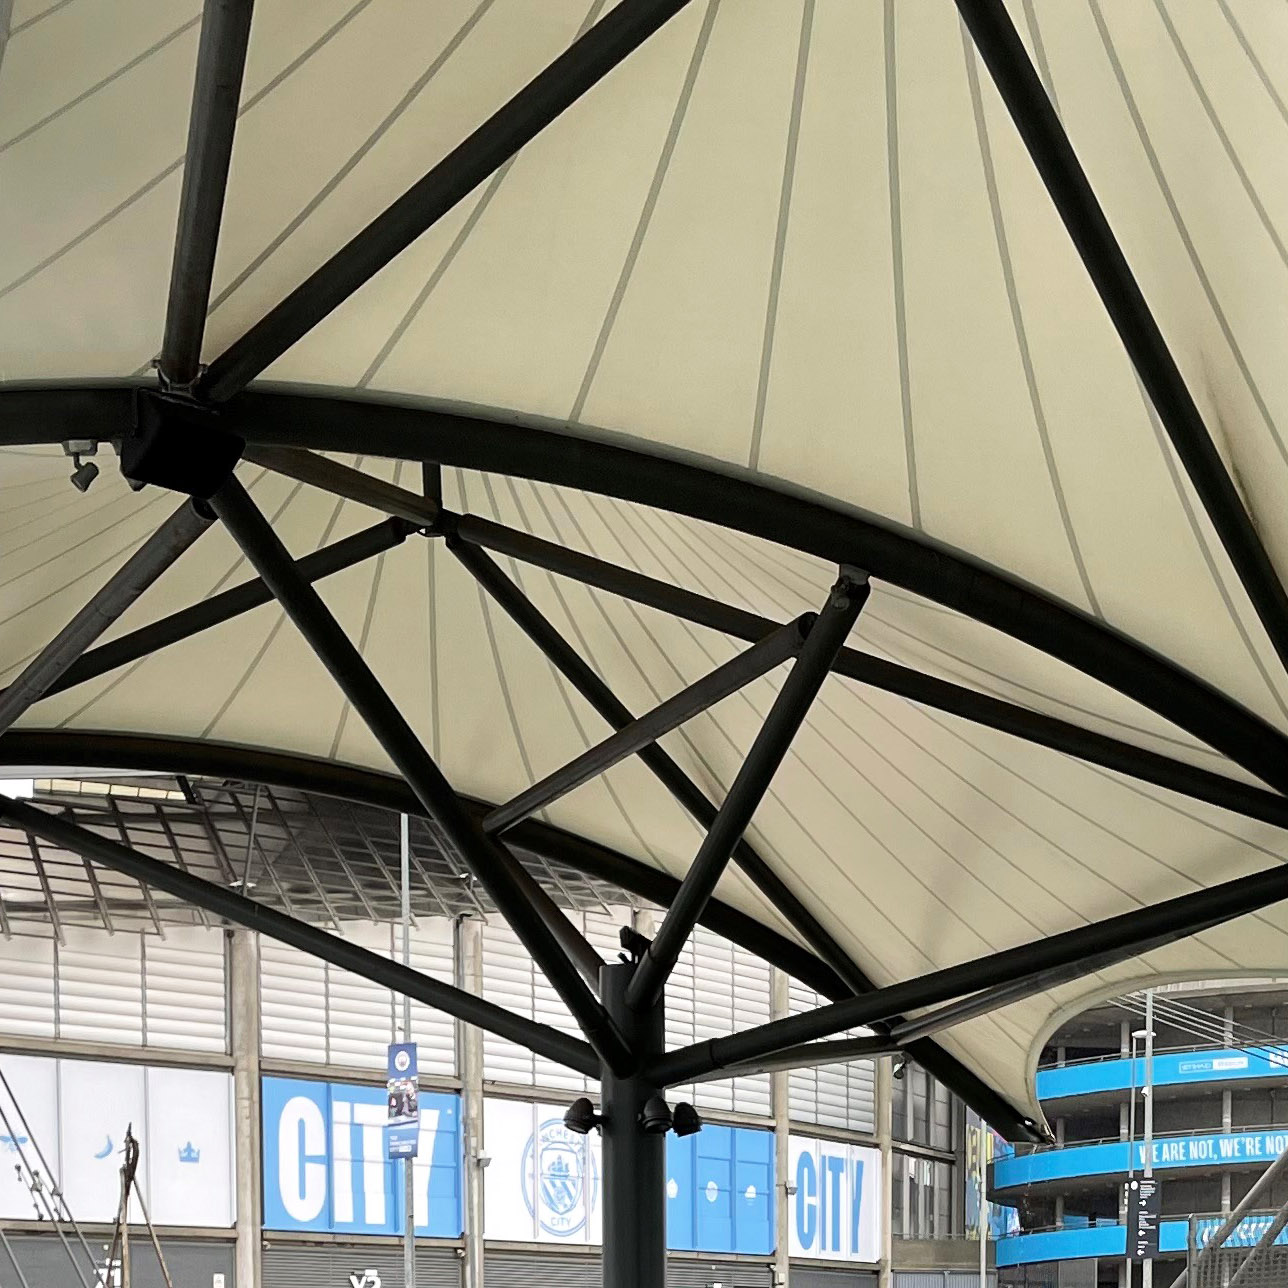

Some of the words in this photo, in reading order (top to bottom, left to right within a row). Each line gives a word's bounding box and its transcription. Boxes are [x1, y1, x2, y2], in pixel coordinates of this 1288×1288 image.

[278, 1096, 440, 1227] CITY
[1162, 1143, 1187, 1162] ARE
[1190, 1139, 1218, 1161] NOT,
[1219, 1136, 1263, 1159] WE'RE
[550, 1216, 572, 1227] CITY
[796, 1151, 864, 1253] CITY
